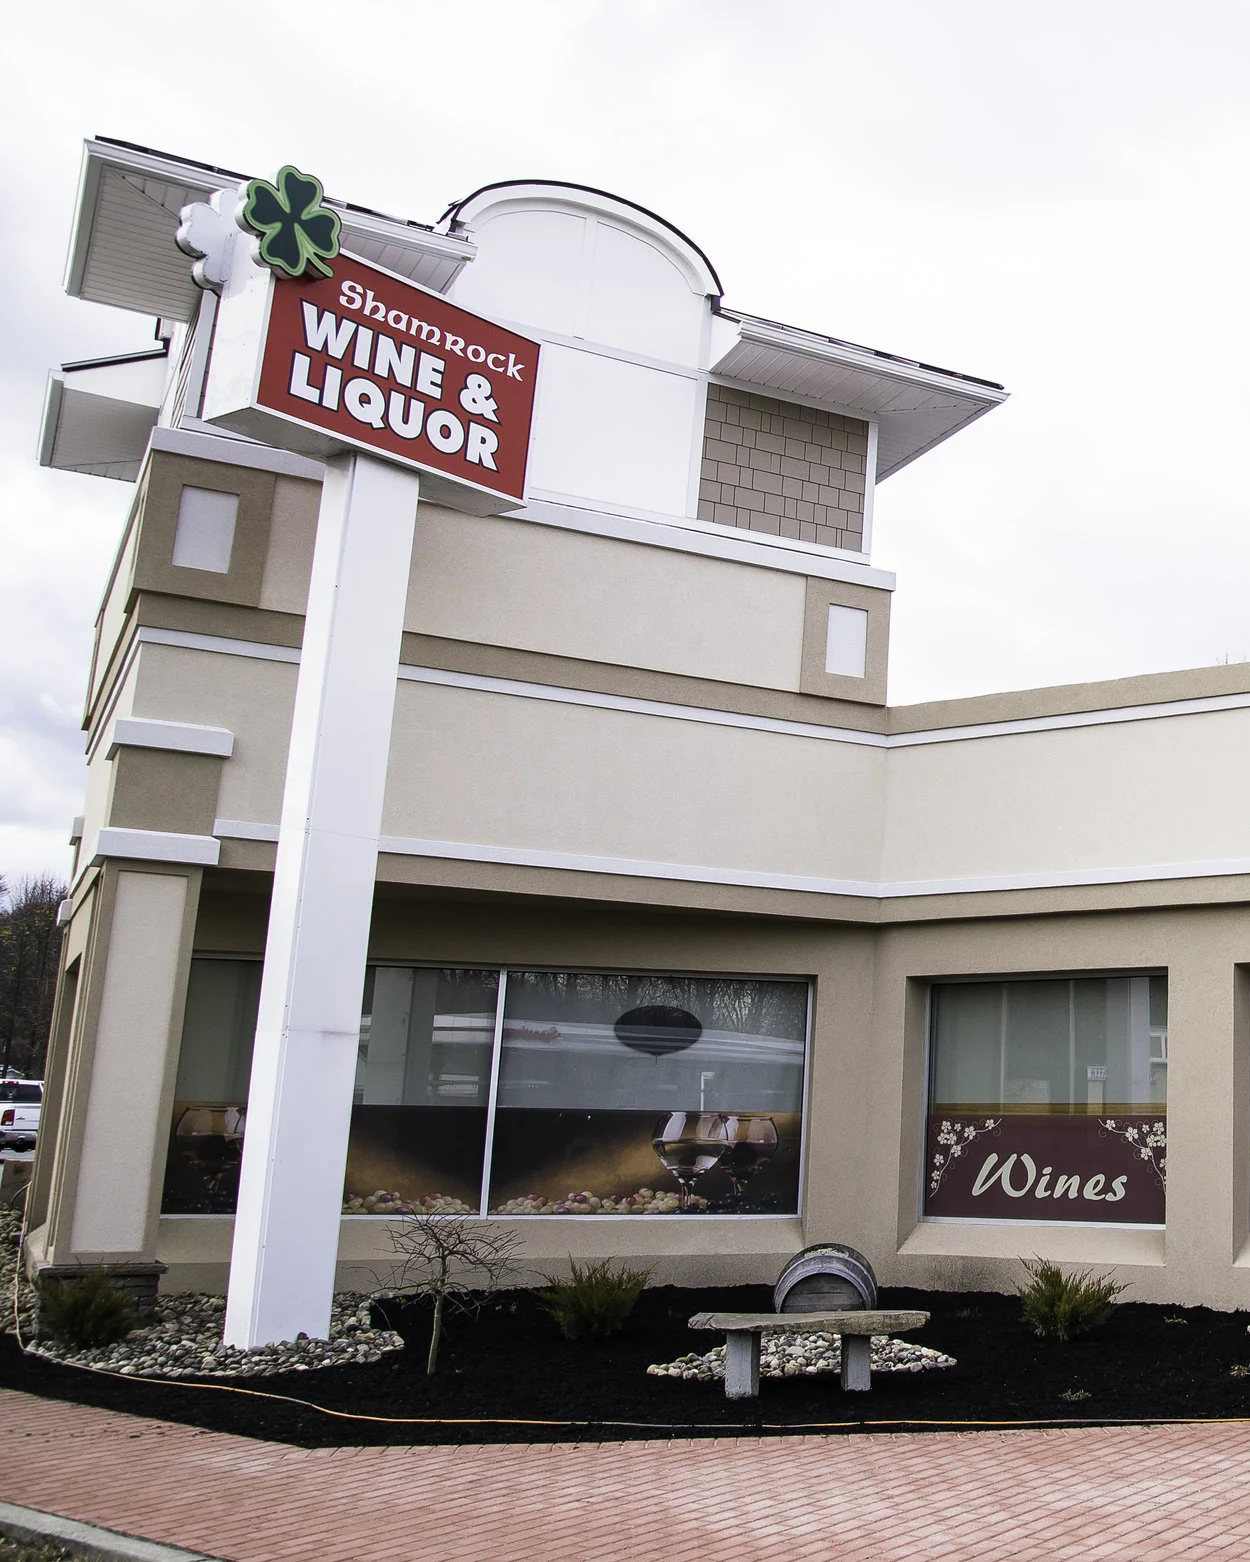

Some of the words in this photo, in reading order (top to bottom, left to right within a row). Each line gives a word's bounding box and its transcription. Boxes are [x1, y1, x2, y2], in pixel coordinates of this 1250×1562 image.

[288, 350, 499, 473] LIQUOR
[300, 299, 446, 400] WINE
[459, 372, 502, 424] &
[971, 1152, 1129, 1202] Wines
